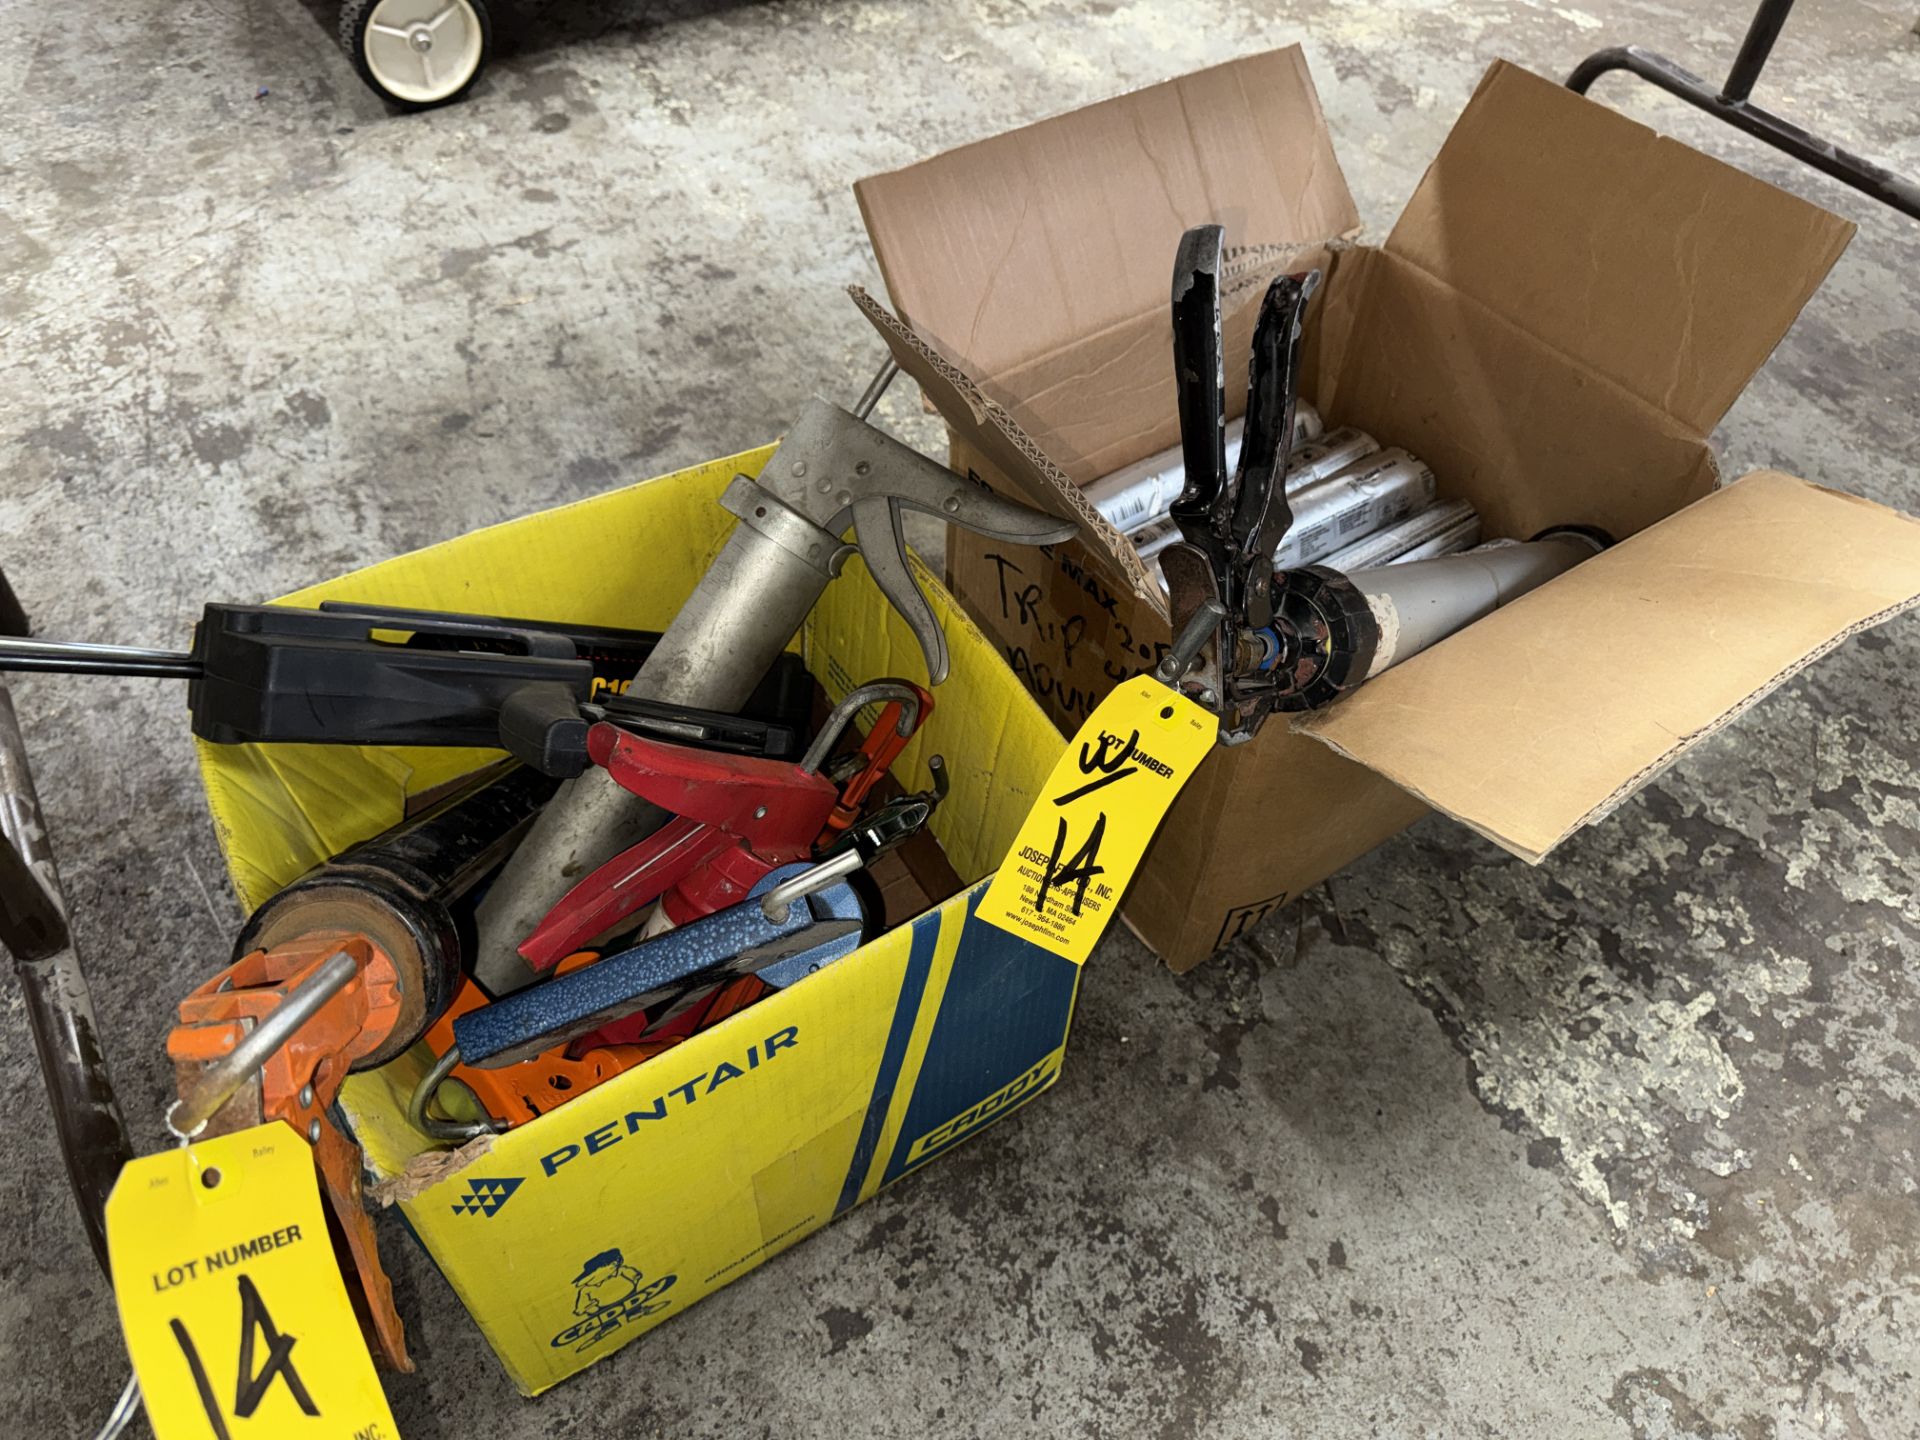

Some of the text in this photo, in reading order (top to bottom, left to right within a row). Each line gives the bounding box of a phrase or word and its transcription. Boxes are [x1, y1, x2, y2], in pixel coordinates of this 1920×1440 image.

[983, 553, 1086, 668] TRIP
[1097, 729, 1174, 780] LOT UMBER
[1018, 845, 1054, 871] JOSEP
[1094, 883, 1112, 901] INC.
[539, 1025, 800, 1178] PENTAIR
[919, 1057, 1053, 1153] CADDY
[153, 1224, 304, 1293] LOT NUMBER
[556, 1278, 670, 1346] CADDY
